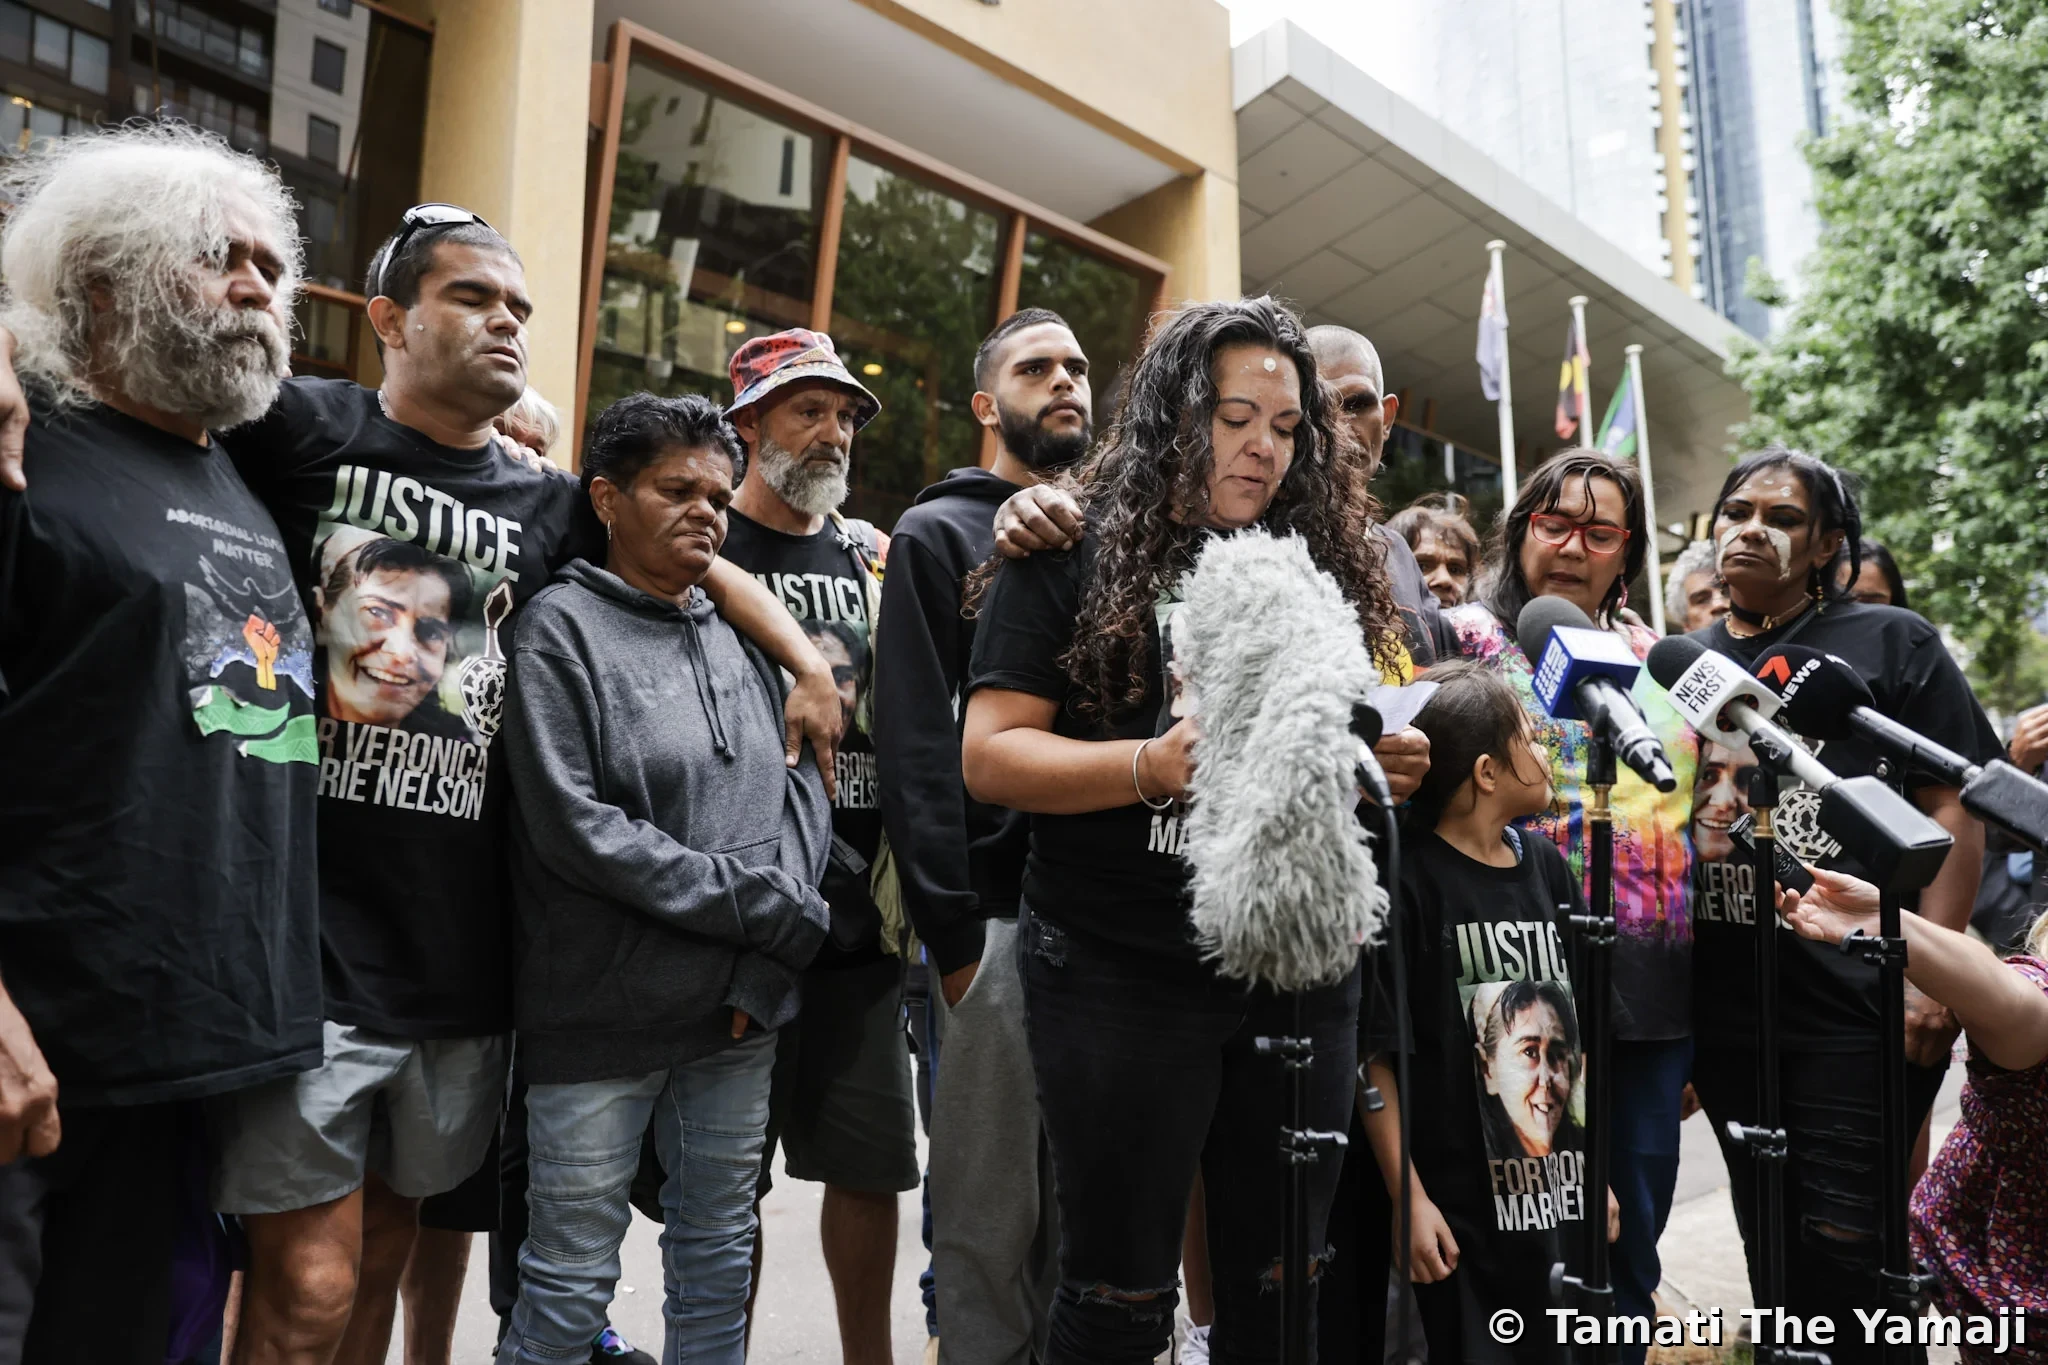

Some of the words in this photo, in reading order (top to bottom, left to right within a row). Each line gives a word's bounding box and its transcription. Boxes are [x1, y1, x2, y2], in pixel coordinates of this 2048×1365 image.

[319, 464, 523, 582] JUSTICE
[213, 538, 275, 569] MATTER
[1675, 660, 1716, 704] NEWS
[1688, 669, 1727, 714] FIRST
[1780, 658, 1821, 708] NEWS
[345, 721, 488, 785] VERONICA
[317, 757, 372, 802] RIE
[373, 765, 486, 821] NELSON
[1456, 920, 1569, 986] JUSTIC
[1488, 1157, 1545, 1195] FOR
[1494, 1192, 1557, 1231] MAR
